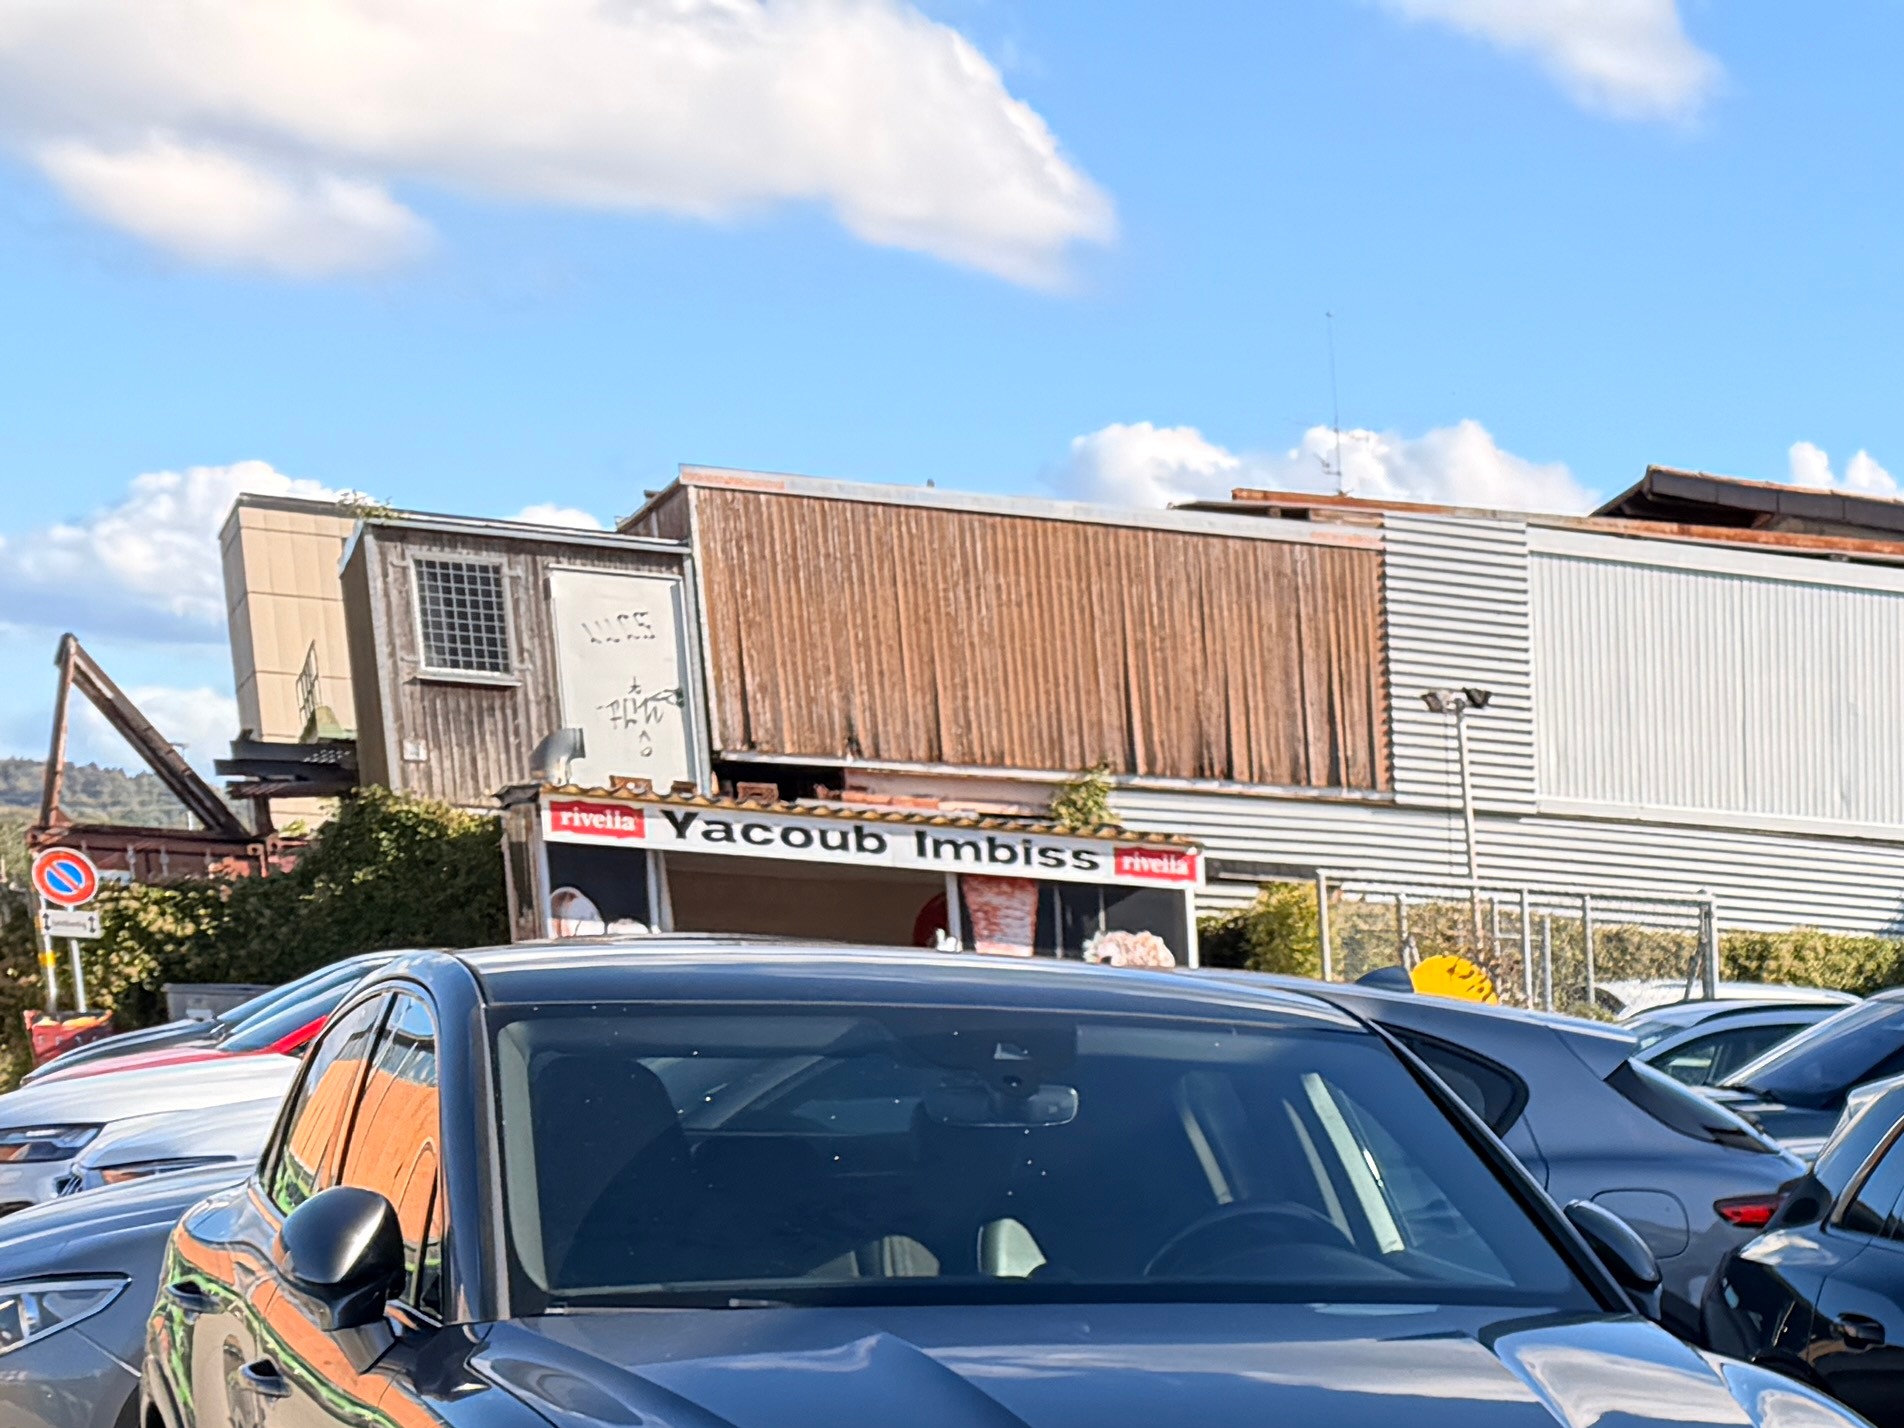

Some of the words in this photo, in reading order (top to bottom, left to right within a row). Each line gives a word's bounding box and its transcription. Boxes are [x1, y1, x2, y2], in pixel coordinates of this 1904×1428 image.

[559, 806, 638, 832] rivella
[660, 808, 888, 854] Yacoub
[914, 830, 1101, 871] Imbiss
